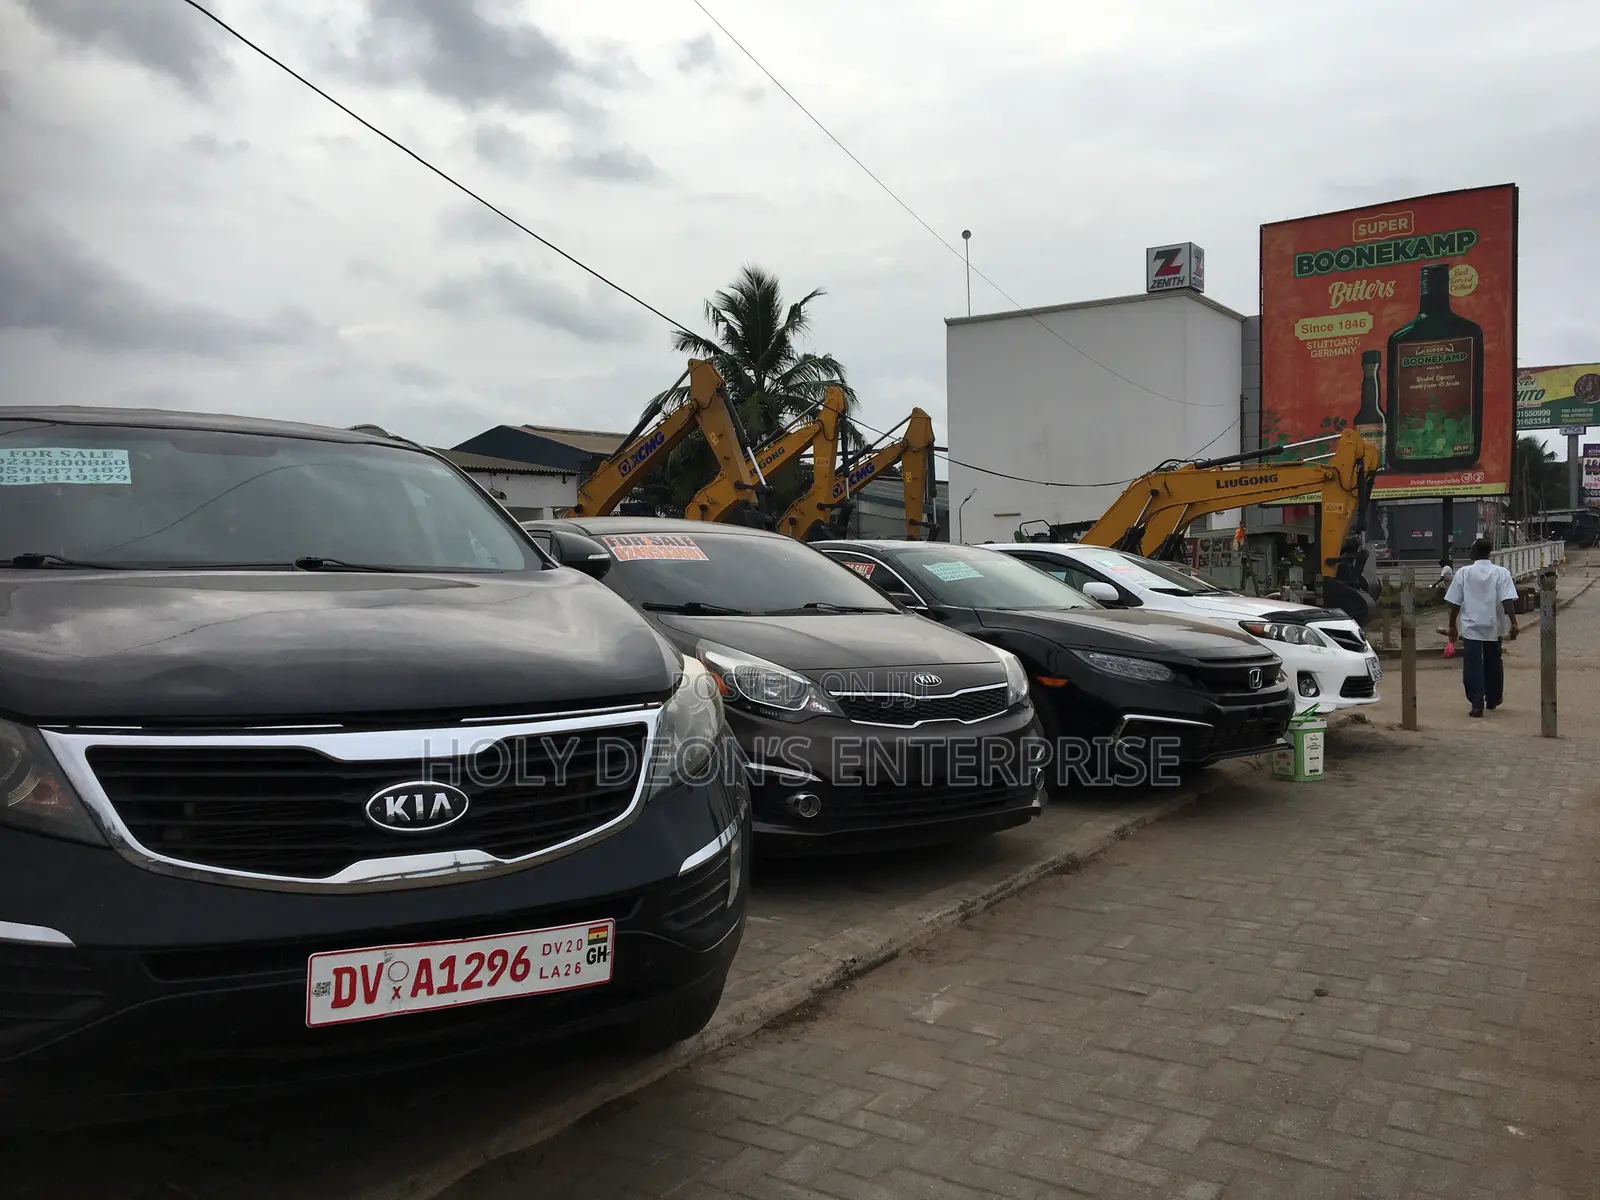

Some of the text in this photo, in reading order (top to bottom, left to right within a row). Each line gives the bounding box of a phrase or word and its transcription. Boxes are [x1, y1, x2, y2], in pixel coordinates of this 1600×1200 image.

[1357, 217, 1409, 236] SUPER
[1295, 229, 1478, 278] BOONEKAMP
[1150, 276, 1185, 289] ZENITH
[1328, 279, 1396, 309] Bitters
[1301, 318, 1367, 334] Since 1846
[1306, 336, 1361, 350] STUTTGART,
[1310, 347, 1356, 358] GERMANY
[1402, 352, 1468, 367] BOONEKAMP
[9, 450, 115, 458] FOR SALE
[631, 431, 665, 468] XCMG
[605, 535, 696, 547] FOR SALE
[919, 675, 939, 684] KIA
[384, 792, 455, 822] KIA
[541, 938, 583, 957] DV20
[586, 946, 608, 965] GH
[331, 962, 384, 1009] DV
[410, 946, 531, 998] A1296
[539, 961, 582, 980] LA26
